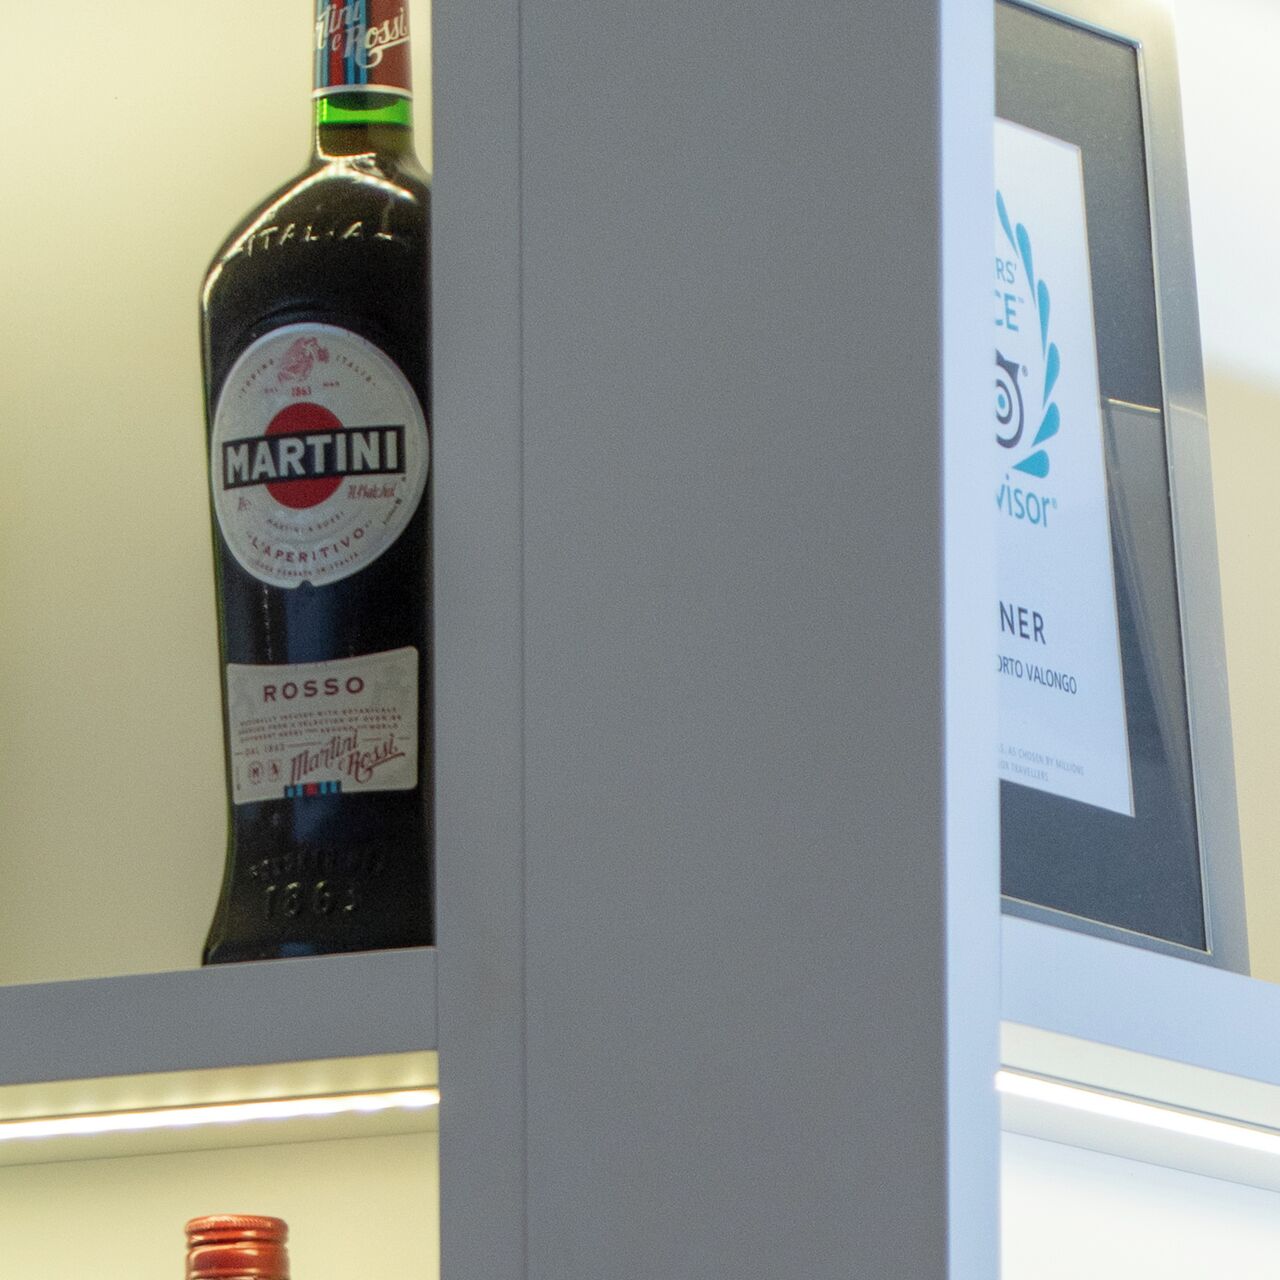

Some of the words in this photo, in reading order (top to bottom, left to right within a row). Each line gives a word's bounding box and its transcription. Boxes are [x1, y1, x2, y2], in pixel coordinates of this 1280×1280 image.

[227, 430, 399, 485] MARTINI
[263, 676, 365, 702] ROSSO
[1026, 663, 1078, 695] VALONGO
[289, 728, 359, 786] Martini
[347, 732, 406, 784] Rossi
